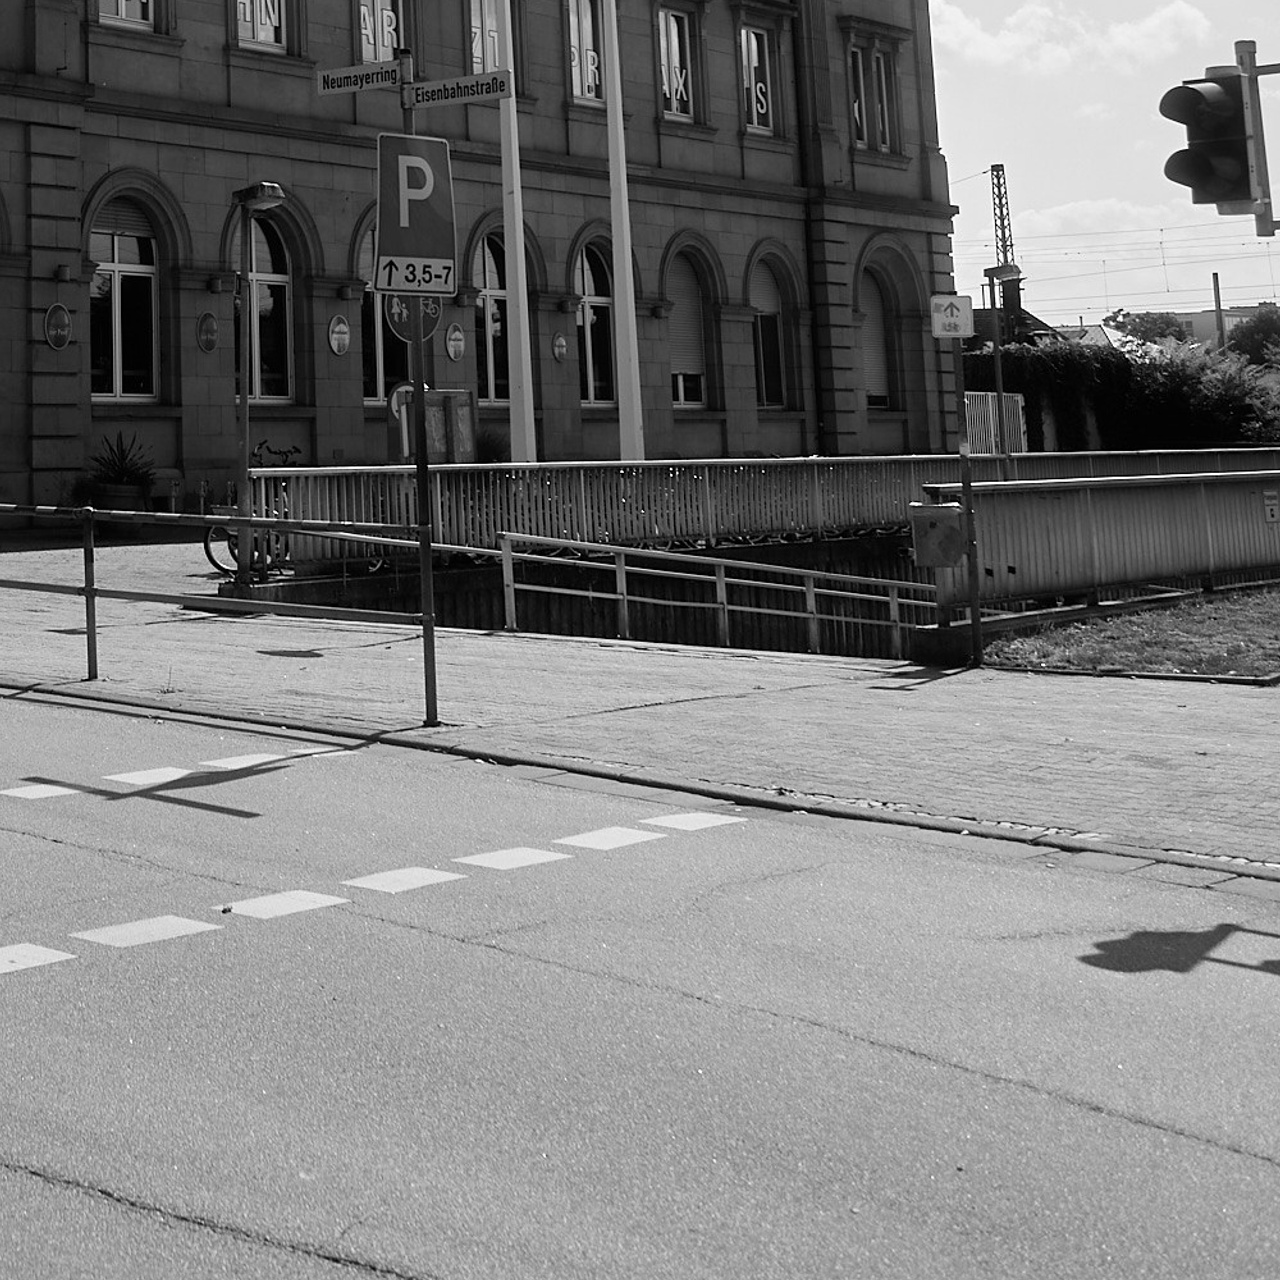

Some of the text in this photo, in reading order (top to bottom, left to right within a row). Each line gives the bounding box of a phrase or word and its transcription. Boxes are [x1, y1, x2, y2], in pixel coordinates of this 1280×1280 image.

[322, 67, 397, 90] Neumayerring
[415, 77, 506, 104] Eisenbahnstraße
[398, 154, 435, 228] P
[404, 263, 452, 287] 3,5-7
